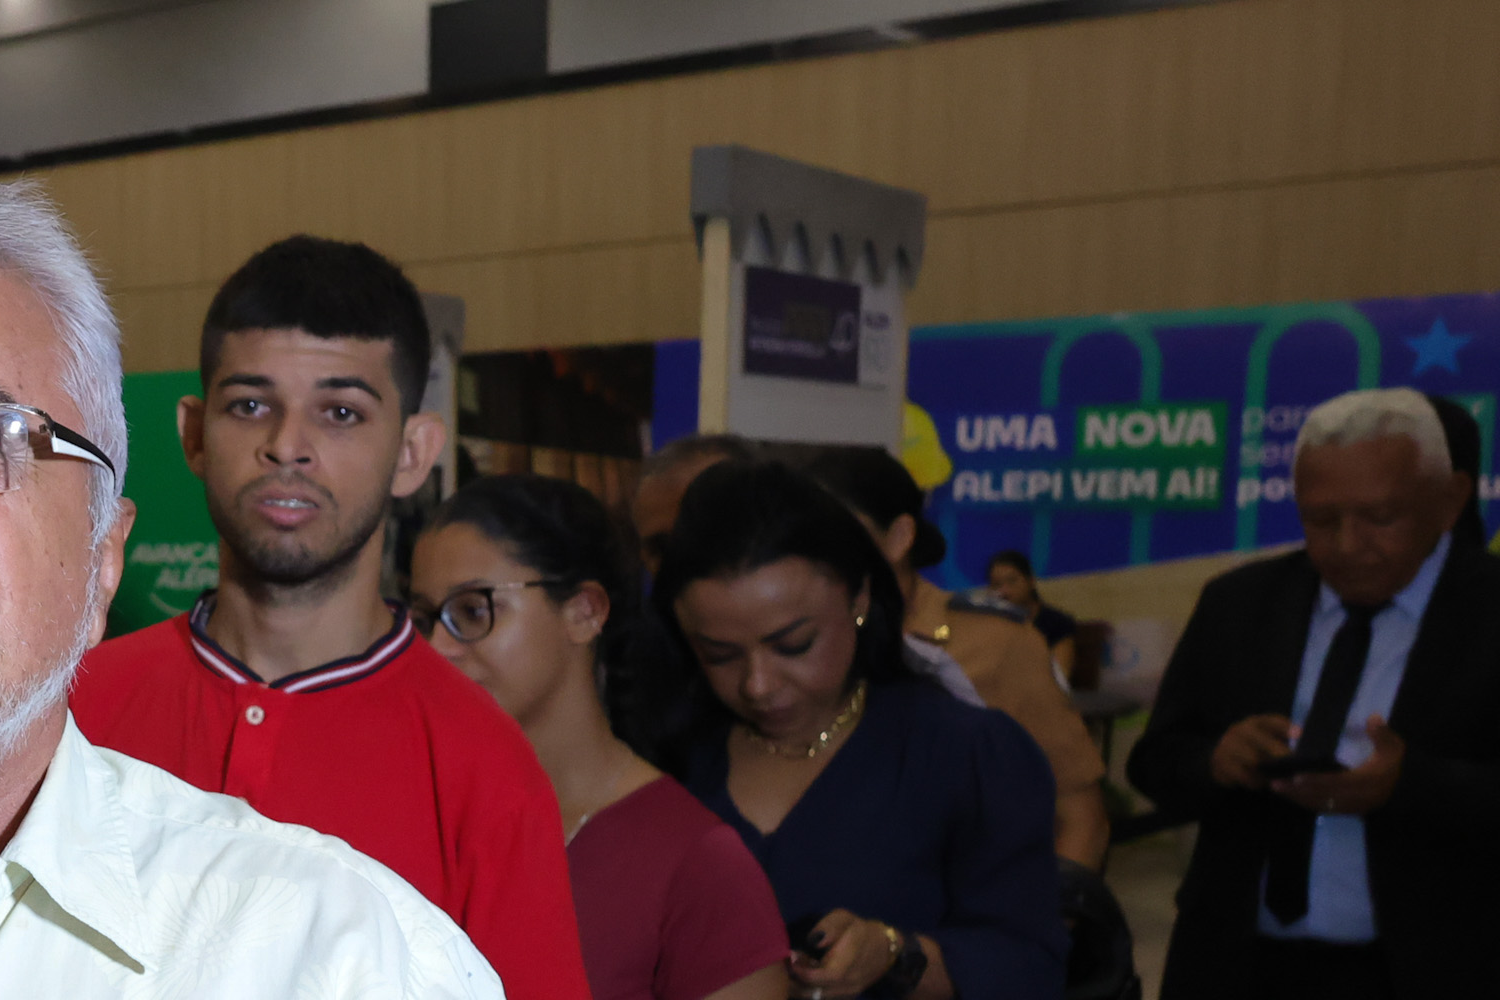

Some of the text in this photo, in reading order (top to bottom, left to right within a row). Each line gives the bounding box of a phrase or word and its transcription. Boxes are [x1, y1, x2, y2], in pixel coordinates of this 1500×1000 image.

[956, 407, 1217, 453] UMA NOVA
[953, 467, 1063, 502] ALEPI
[1071, 466, 1158, 502] VEM
